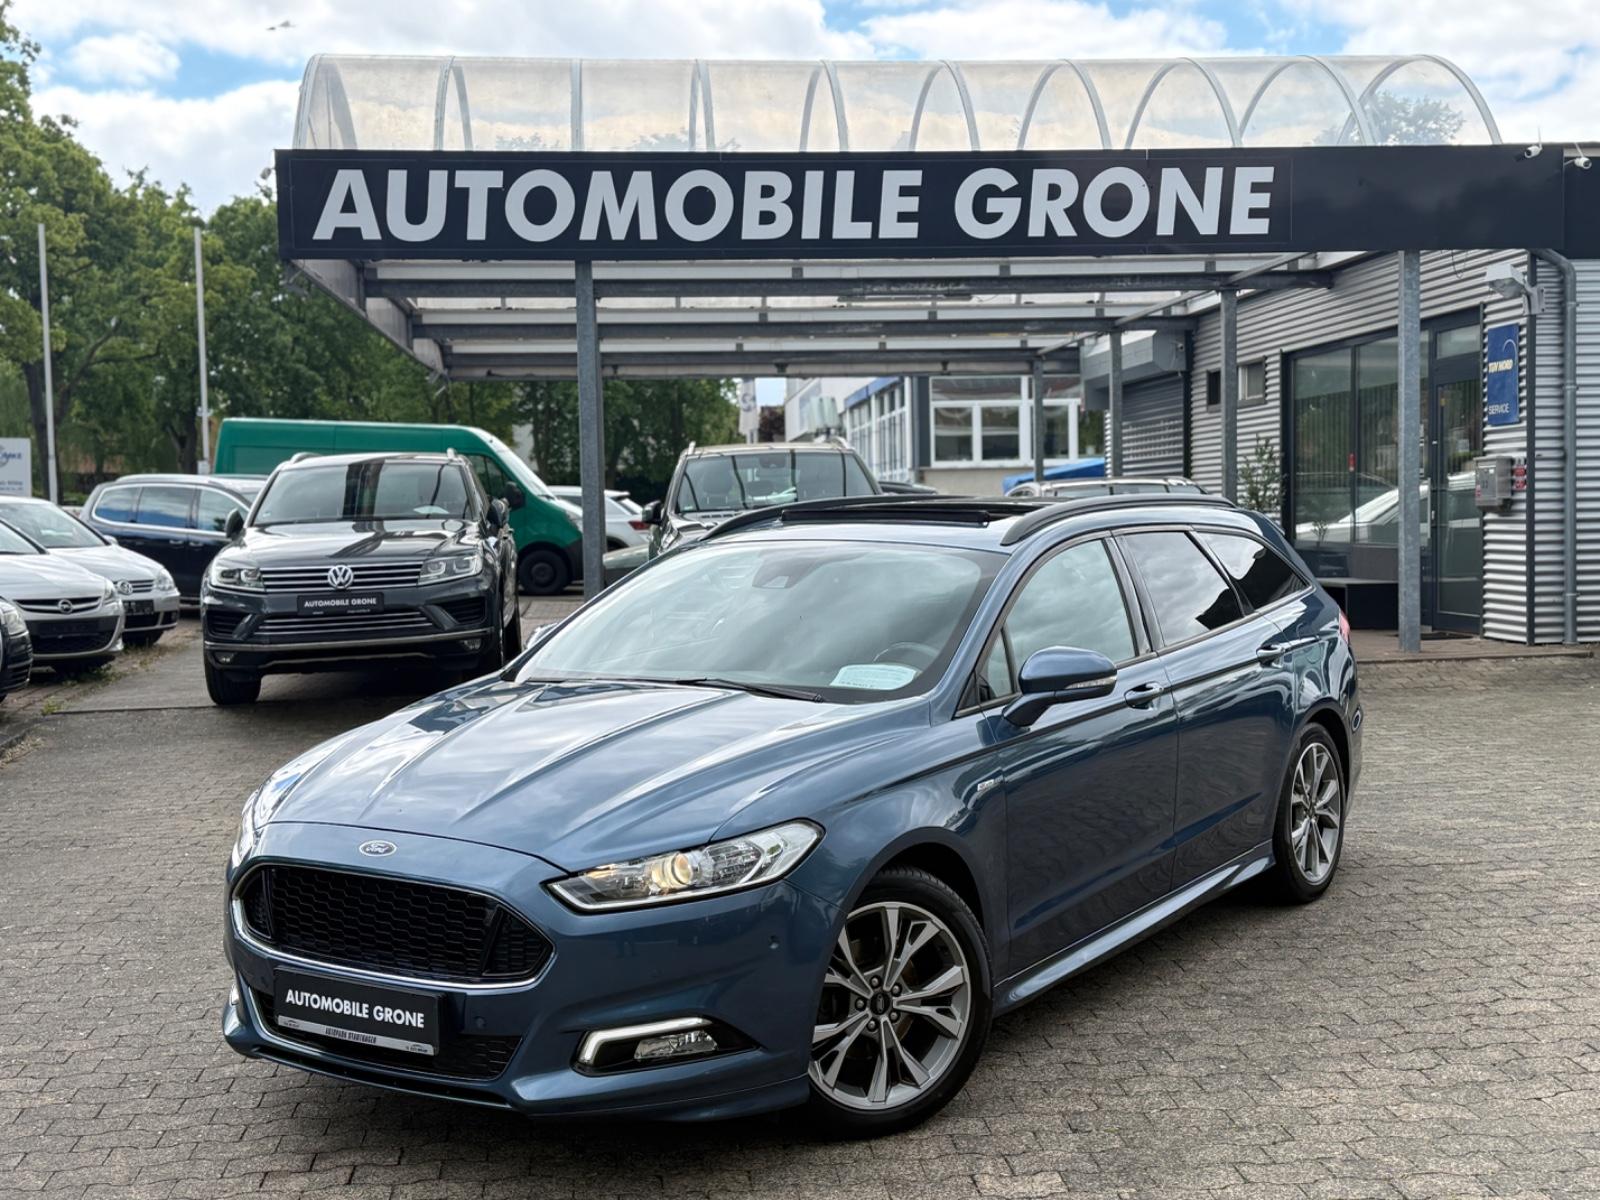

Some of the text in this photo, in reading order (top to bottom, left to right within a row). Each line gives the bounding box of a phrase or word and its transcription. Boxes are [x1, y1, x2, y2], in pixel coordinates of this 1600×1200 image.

[312, 165, 1275, 243] AUTOMOBILE GRONE
[1488, 403, 1510, 415] SERVICE
[304, 597, 377, 608] AUTOMOBILE GRONE
[285, 989, 425, 1028] AUTOMOBILE GRONE
